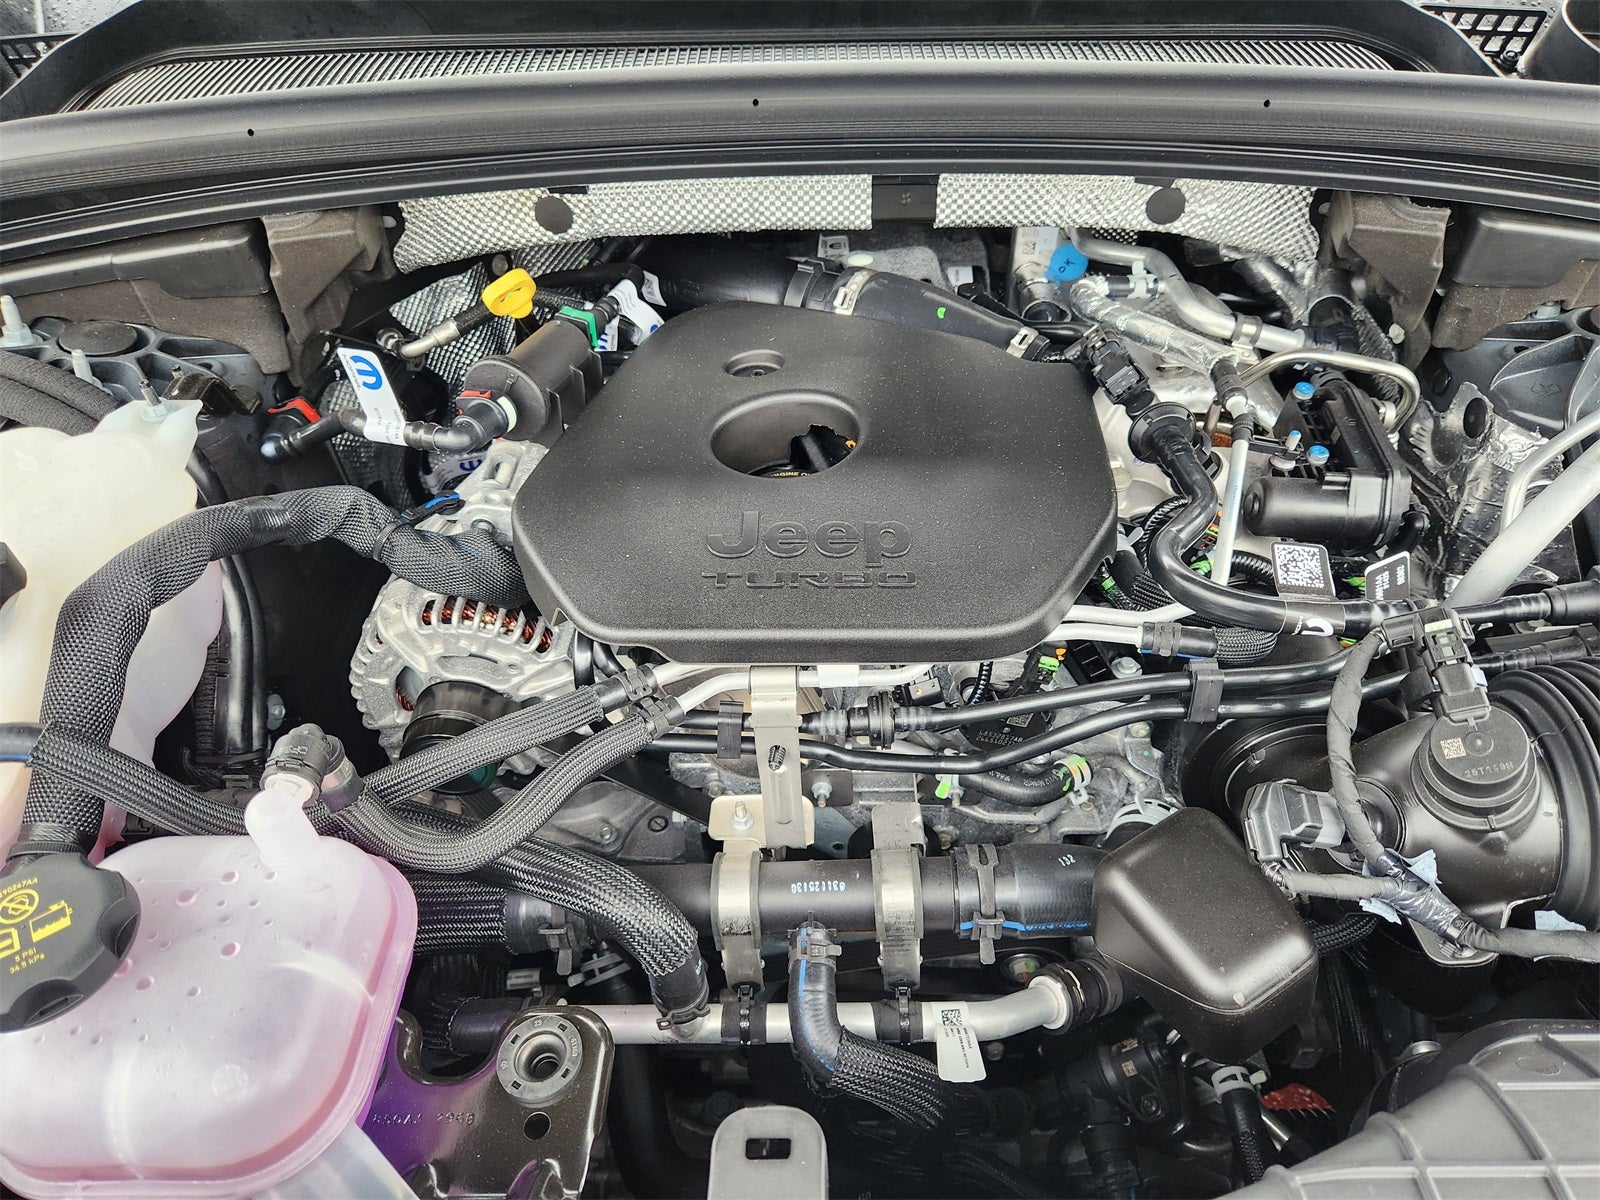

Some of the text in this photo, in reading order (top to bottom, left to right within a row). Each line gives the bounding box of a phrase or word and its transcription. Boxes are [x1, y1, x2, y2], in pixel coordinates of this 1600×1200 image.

[706, 510, 912, 568] Jeep
[701, 571, 917, 588] TURBO
[22, 948, 36, 960] PSI
